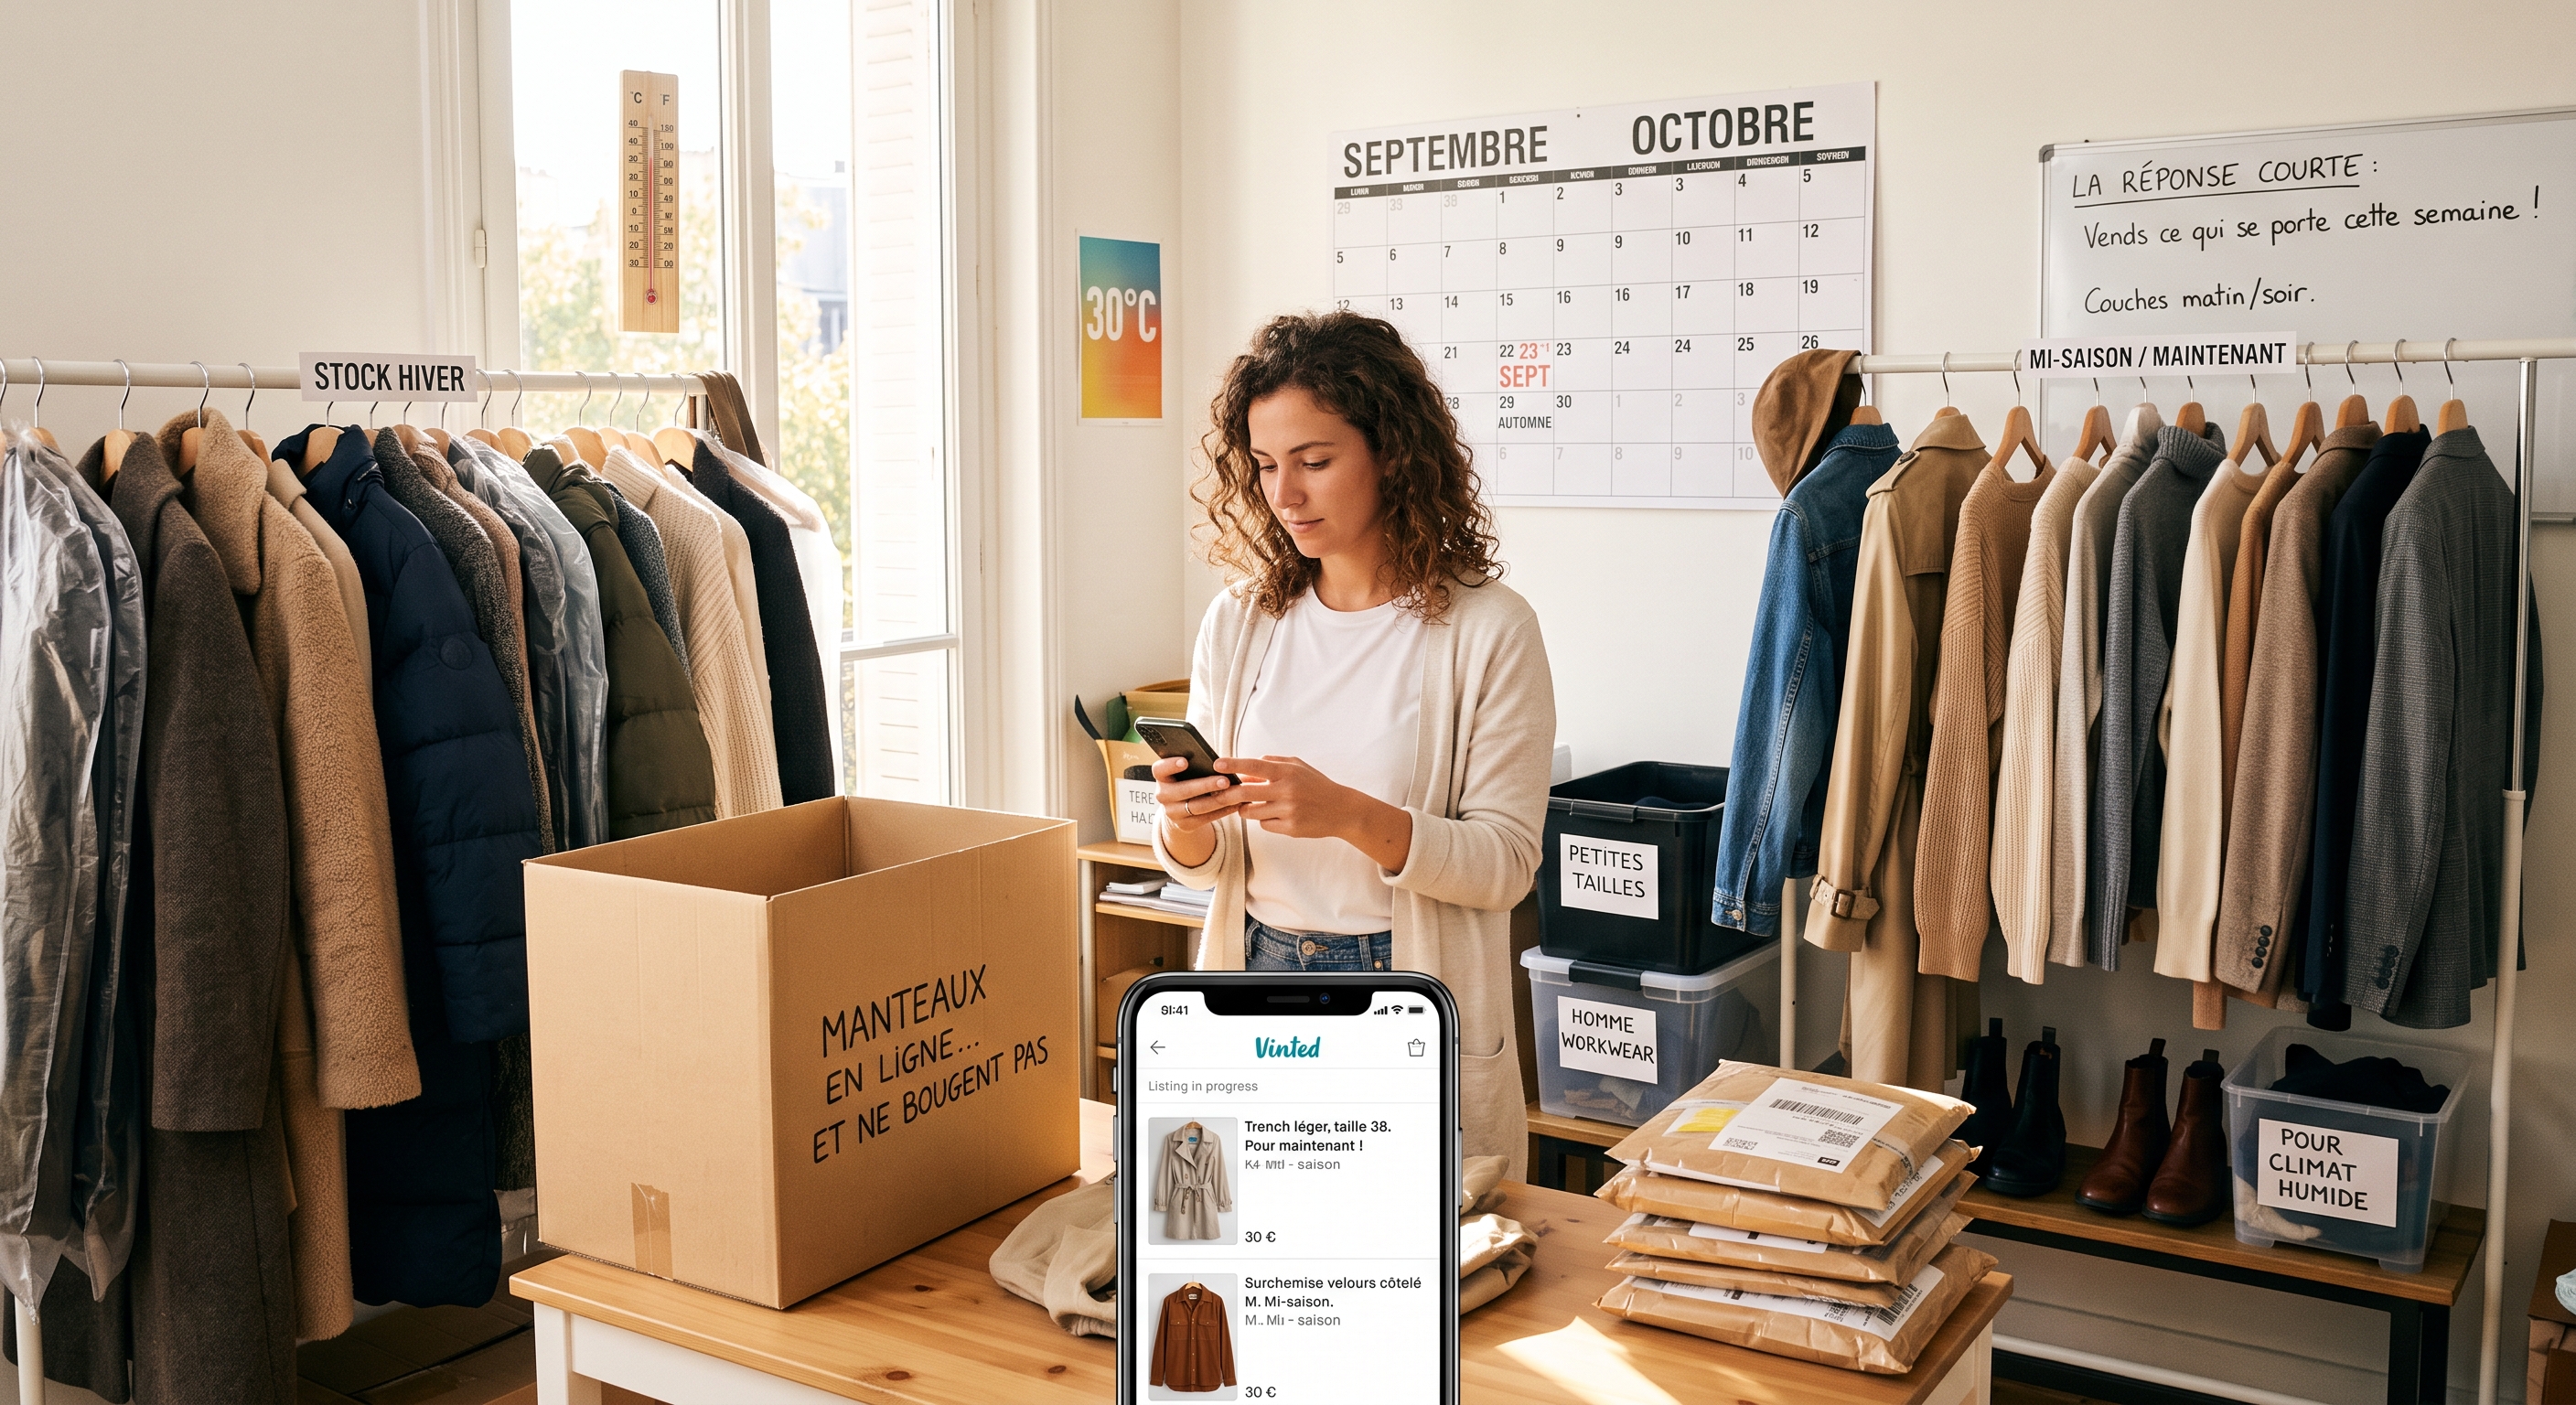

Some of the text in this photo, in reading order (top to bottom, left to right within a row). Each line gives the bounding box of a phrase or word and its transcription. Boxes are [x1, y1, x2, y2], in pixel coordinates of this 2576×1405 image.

[1344, 102, 1814, 178] SEPTEMBRE OCTOBRE
[1499, 190, 1505, 204] 1
[1556, 186, 1564, 200] 2
[1615, 182, 1623, 197] 3
[1675, 177, 1684, 192] 3
[1737, 173, 1747, 188] 4
[1803, 168, 1811, 183] 5
[2072, 174, 2102, 198] LA
[2123, 160, 2239, 193] RÉPONSE
[2259, 154, 2364, 183] COURTE
[2084, 222, 2149, 249] Vends
[2160, 228, 2183, 243] ce
[2192, 220, 2224, 252] qui
[2237, 221, 2260, 238] se
[2272, 209, 2330, 246] porte
[2344, 202, 2400, 230] cette
[2413, 200, 2520, 226] semaine
[1336, 223, 1819, 264] 5 6 7 8 9 9 10 11 12
[1390, 297, 1403, 311] 13
[1444, 295, 1459, 308] 14
[1499, 293, 1514, 306] 15
[1556, 290, 1572, 304] 16
[1615, 287, 1630, 302] 16
[1675, 284, 1691, 299] 17
[1738, 282, 1755, 297] 18
[1802, 279, 1819, 295] 19
[2084, 287, 2169, 314] Couches
[1086, 285, 1157, 343] 30°C
[1444, 346, 1457, 359] 21
[1499, 344, 1514, 358] 22
[1519, 342, 1539, 359] 23
[1556, 342, 1572, 356] 23
[1614, 340, 1631, 355] 24
[1675, 338, 1691, 353] 24
[1737, 337, 1755, 351] 25
[1801, 335, 1819, 349] 26
[2030, 342, 2287, 370] MI-SAISON / MAINTENANT
[314, 362, 466, 391] STOCK HIVER
[1499, 364, 1551, 389] SEPT
[1499, 395, 1515, 409] 29
[1556, 394, 1572, 409] 30
[1616, 395, 1621, 408] 1
[1674, 393, 1683, 407] 2
[1737, 393, 1745, 406] 3
[1497, 415, 1552, 429] AUTOMNE
[1499, 447, 1754, 460] 6 7 8 9 10
[1570, 845, 1644, 872] PETITES
[1572, 873, 1646, 898] TAILLES
[822, 963, 987, 1058] MANTEAUX
[1572, 1009, 1635, 1035] HOMME
[1255, 1035, 1321, 1059] Vinted
[1562, 1032, 1655, 1064] WORKWEAR
[827, 1063, 862, 1105] EN
[1148, 1080, 1259, 1095] Listing in progress
[814, 1035, 1047, 1164] ET NE BOUGENT PAS
[1244, 1120, 1391, 1136] Trench léger, taille 38.
[2281, 1128, 2344, 1155] POUR
[1245, 1140, 1276, 1152] Pour
[1279, 1139, 1356, 1152] maintenant
[1298, 1158, 1339, 1169] saison
[2269, 1153, 2357, 1182] CLIMAT
[2279, 1179, 2368, 1210] HUMIDE
[1244, 1230, 1276, 1243] 30 €
[1244, 1276, 1422, 1289] Surchemise velours côtelé
[1245, 1296, 1334, 1307] M. Mi-saison.
[1297, 1314, 1341, 1326] saison
[1245, 1386, 1277, 1399] 30 €
